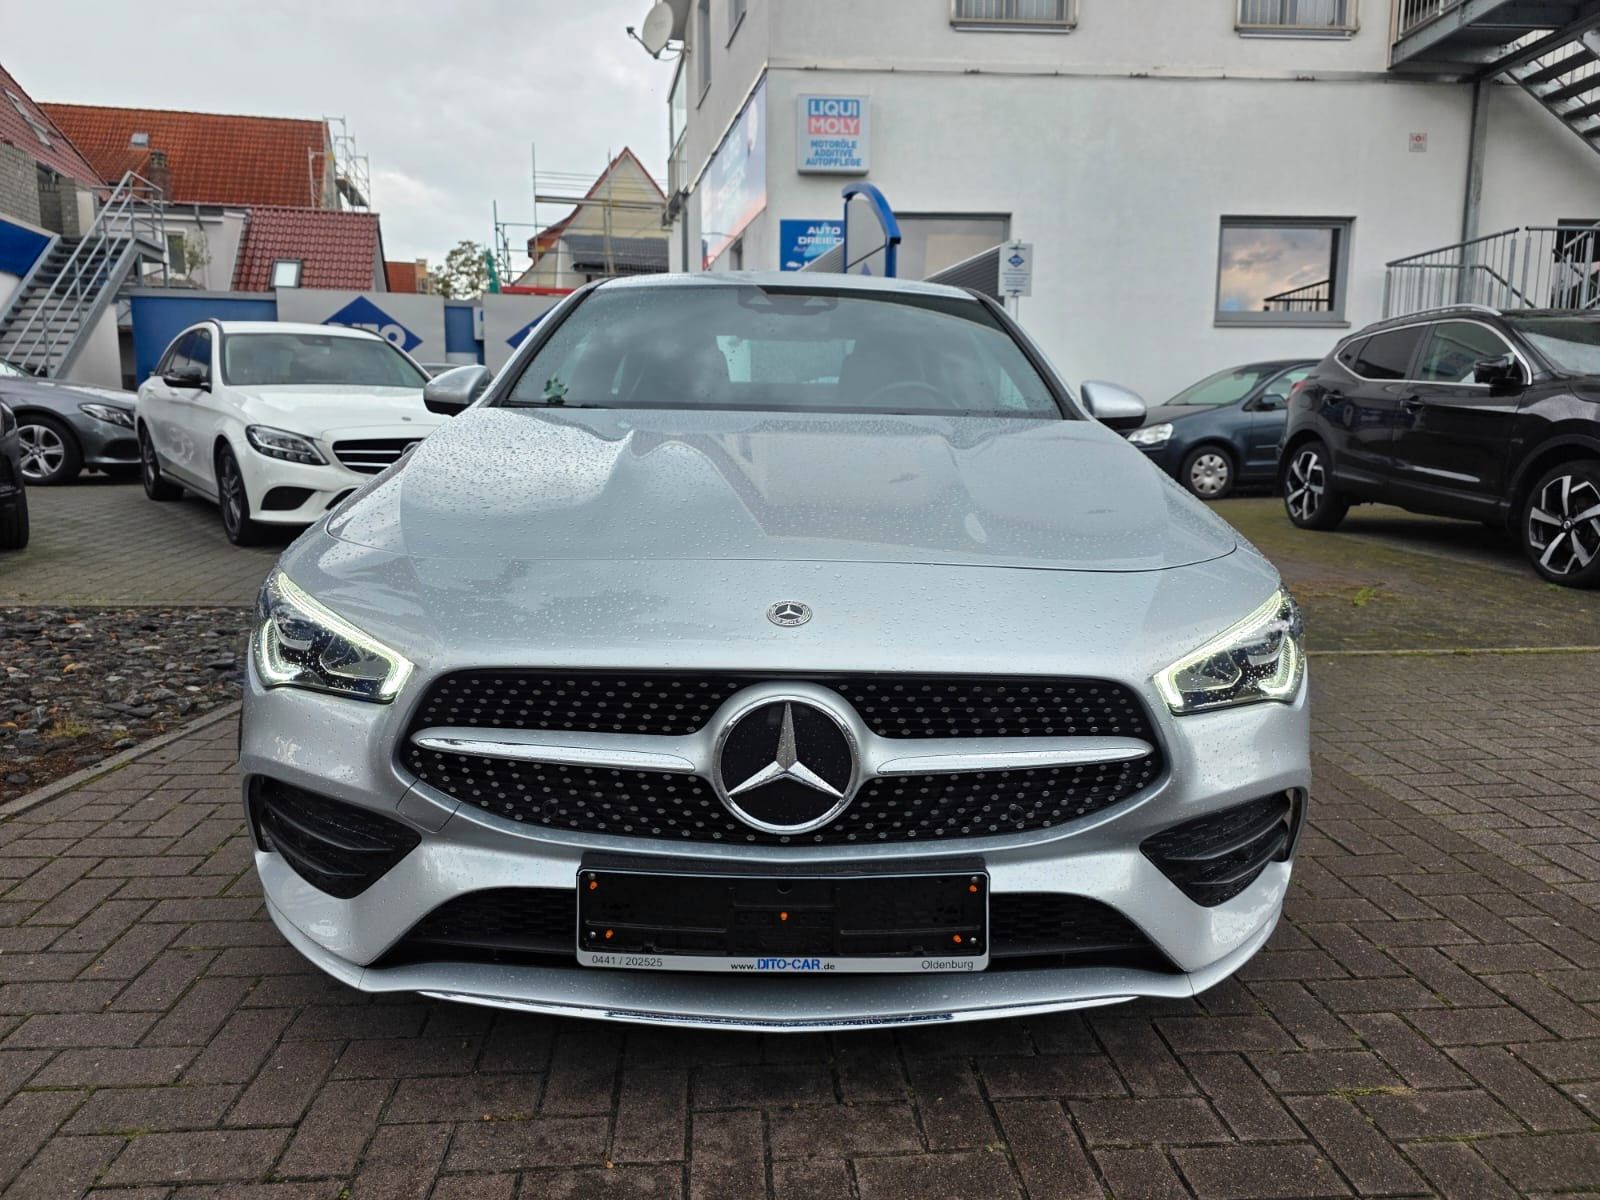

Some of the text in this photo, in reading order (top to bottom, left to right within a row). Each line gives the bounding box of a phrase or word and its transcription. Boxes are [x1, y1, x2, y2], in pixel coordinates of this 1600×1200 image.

[810, 100, 858, 117] LIQUI
[810, 117, 858, 133] MOLY
[810, 139, 857, 149] MOTORÖLE
[814, 149, 853, 157] ADDITIVE
[805, 157, 862, 167] AUTOPFLEGE
[807, 226, 841, 234] AUTO
[591, 954, 616, 965] 0441
[625, 956, 663, 967] 202525
[730, 958, 836, 971] www.DITO-CAR.de
[921, 959, 974, 970] Oldenburg
